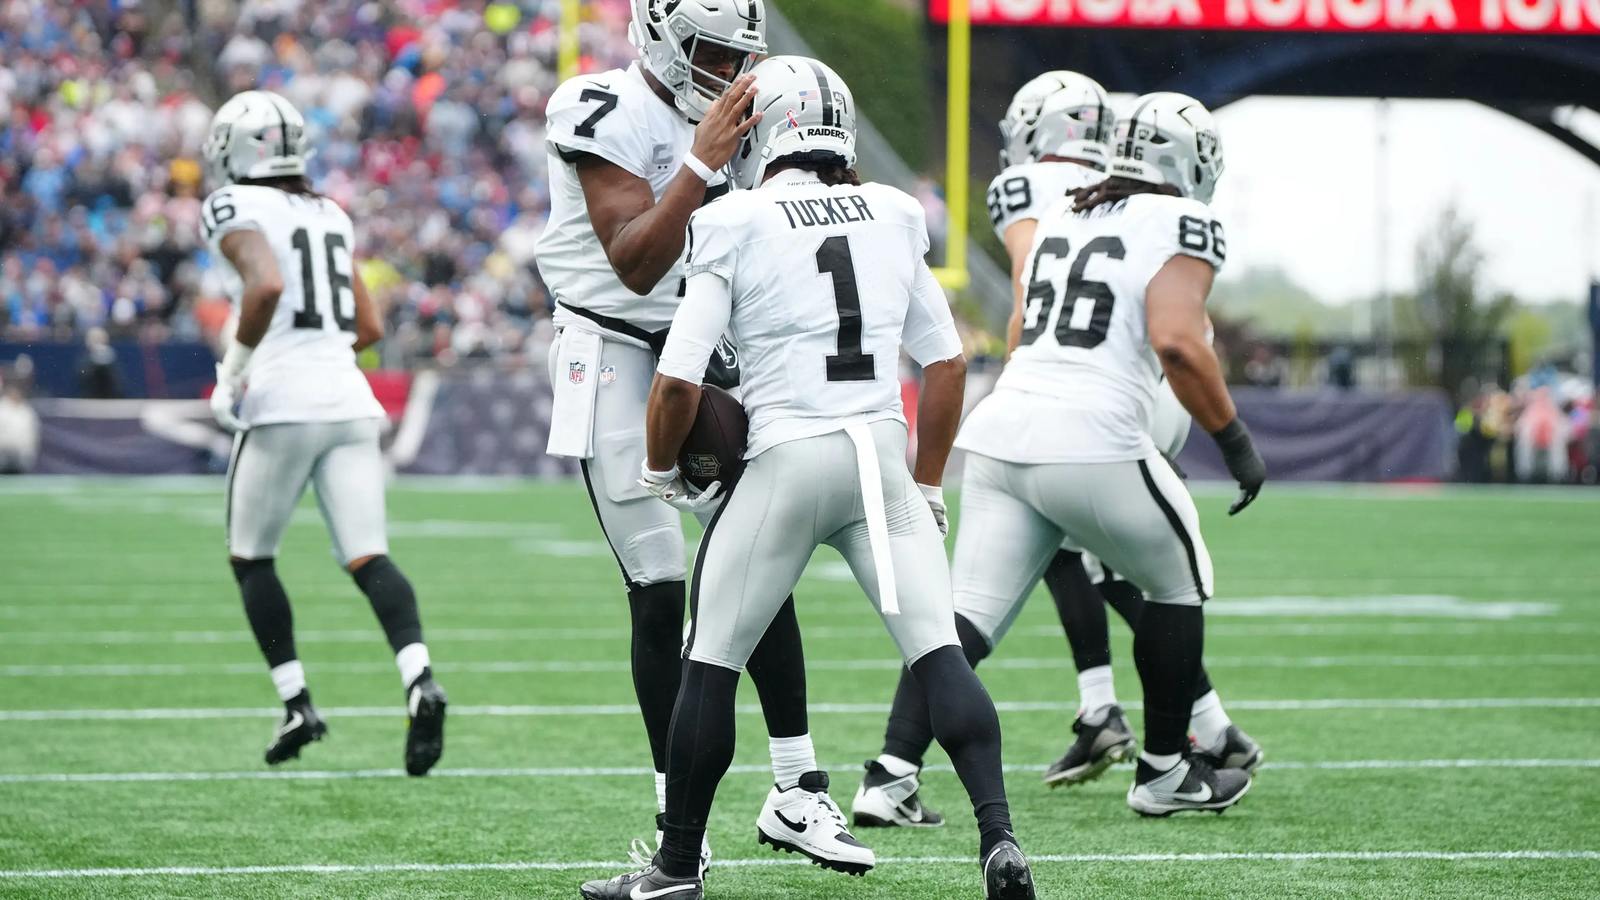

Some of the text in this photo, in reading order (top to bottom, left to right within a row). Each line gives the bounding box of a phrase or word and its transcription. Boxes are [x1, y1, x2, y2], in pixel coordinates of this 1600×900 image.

[574, 89, 618, 139] 7
[807, 128, 846, 140] RAIDERS
[835, 109, 842, 128] 1
[652, 144, 674, 165] C
[775, 194, 875, 229] TUCKER
[291, 227, 356, 332] 16
[1021, 236, 1126, 348] 66
[814, 235, 877, 382] 1
